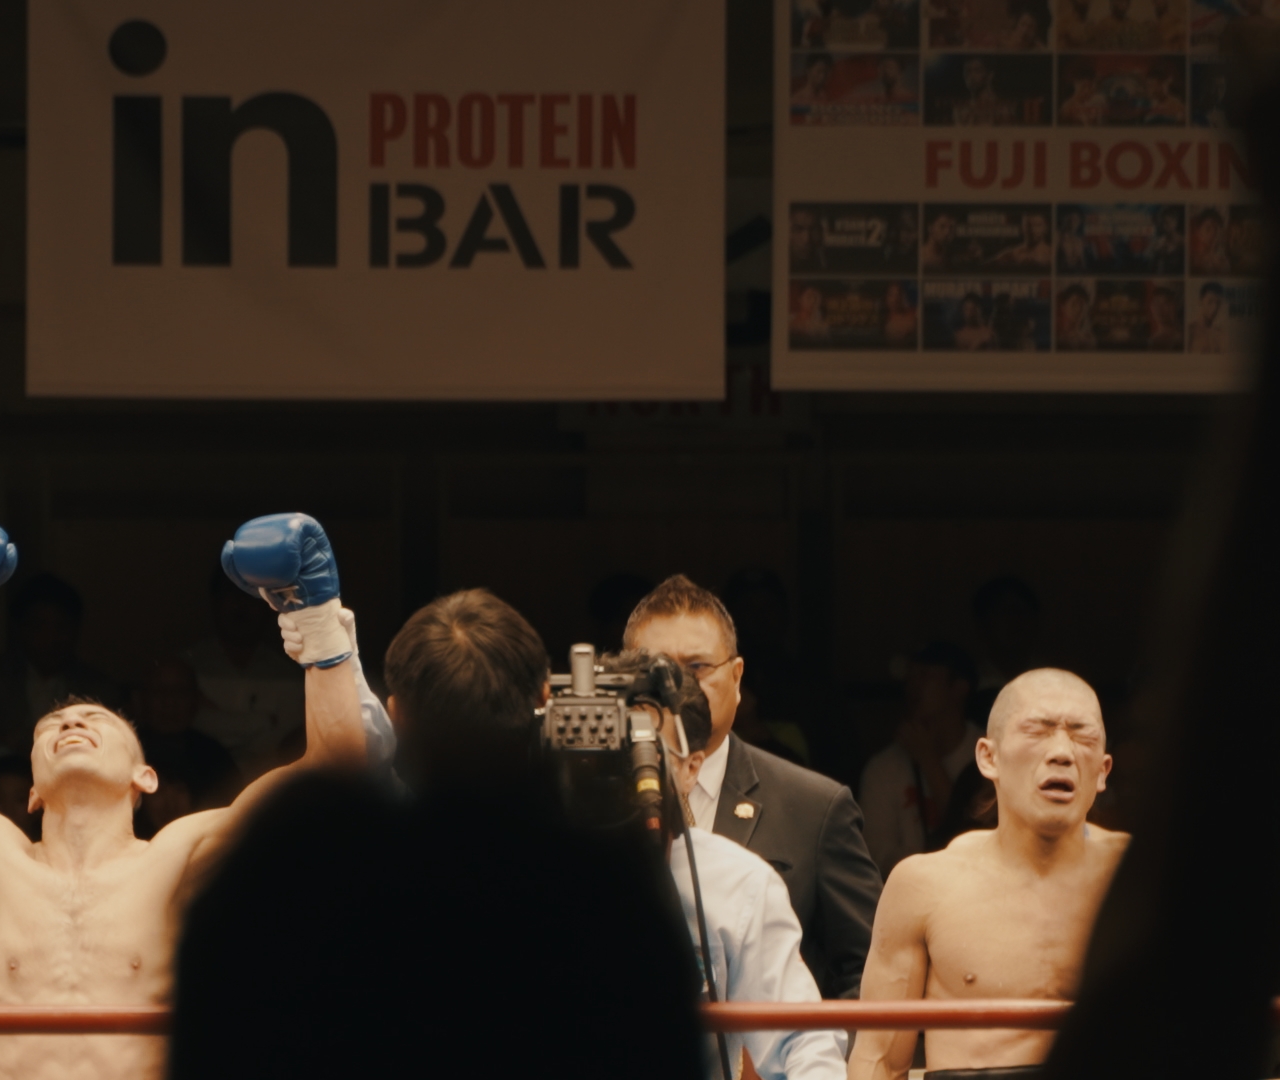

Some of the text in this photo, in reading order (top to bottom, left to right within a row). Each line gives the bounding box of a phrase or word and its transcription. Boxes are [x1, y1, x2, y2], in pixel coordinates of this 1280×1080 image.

[107, 19, 338, 268] in
[369, 92, 637, 169] PROTEIN
[925, 140, 1260, 189] FUJI BOXIN
[369, 183, 637, 270] BAR
